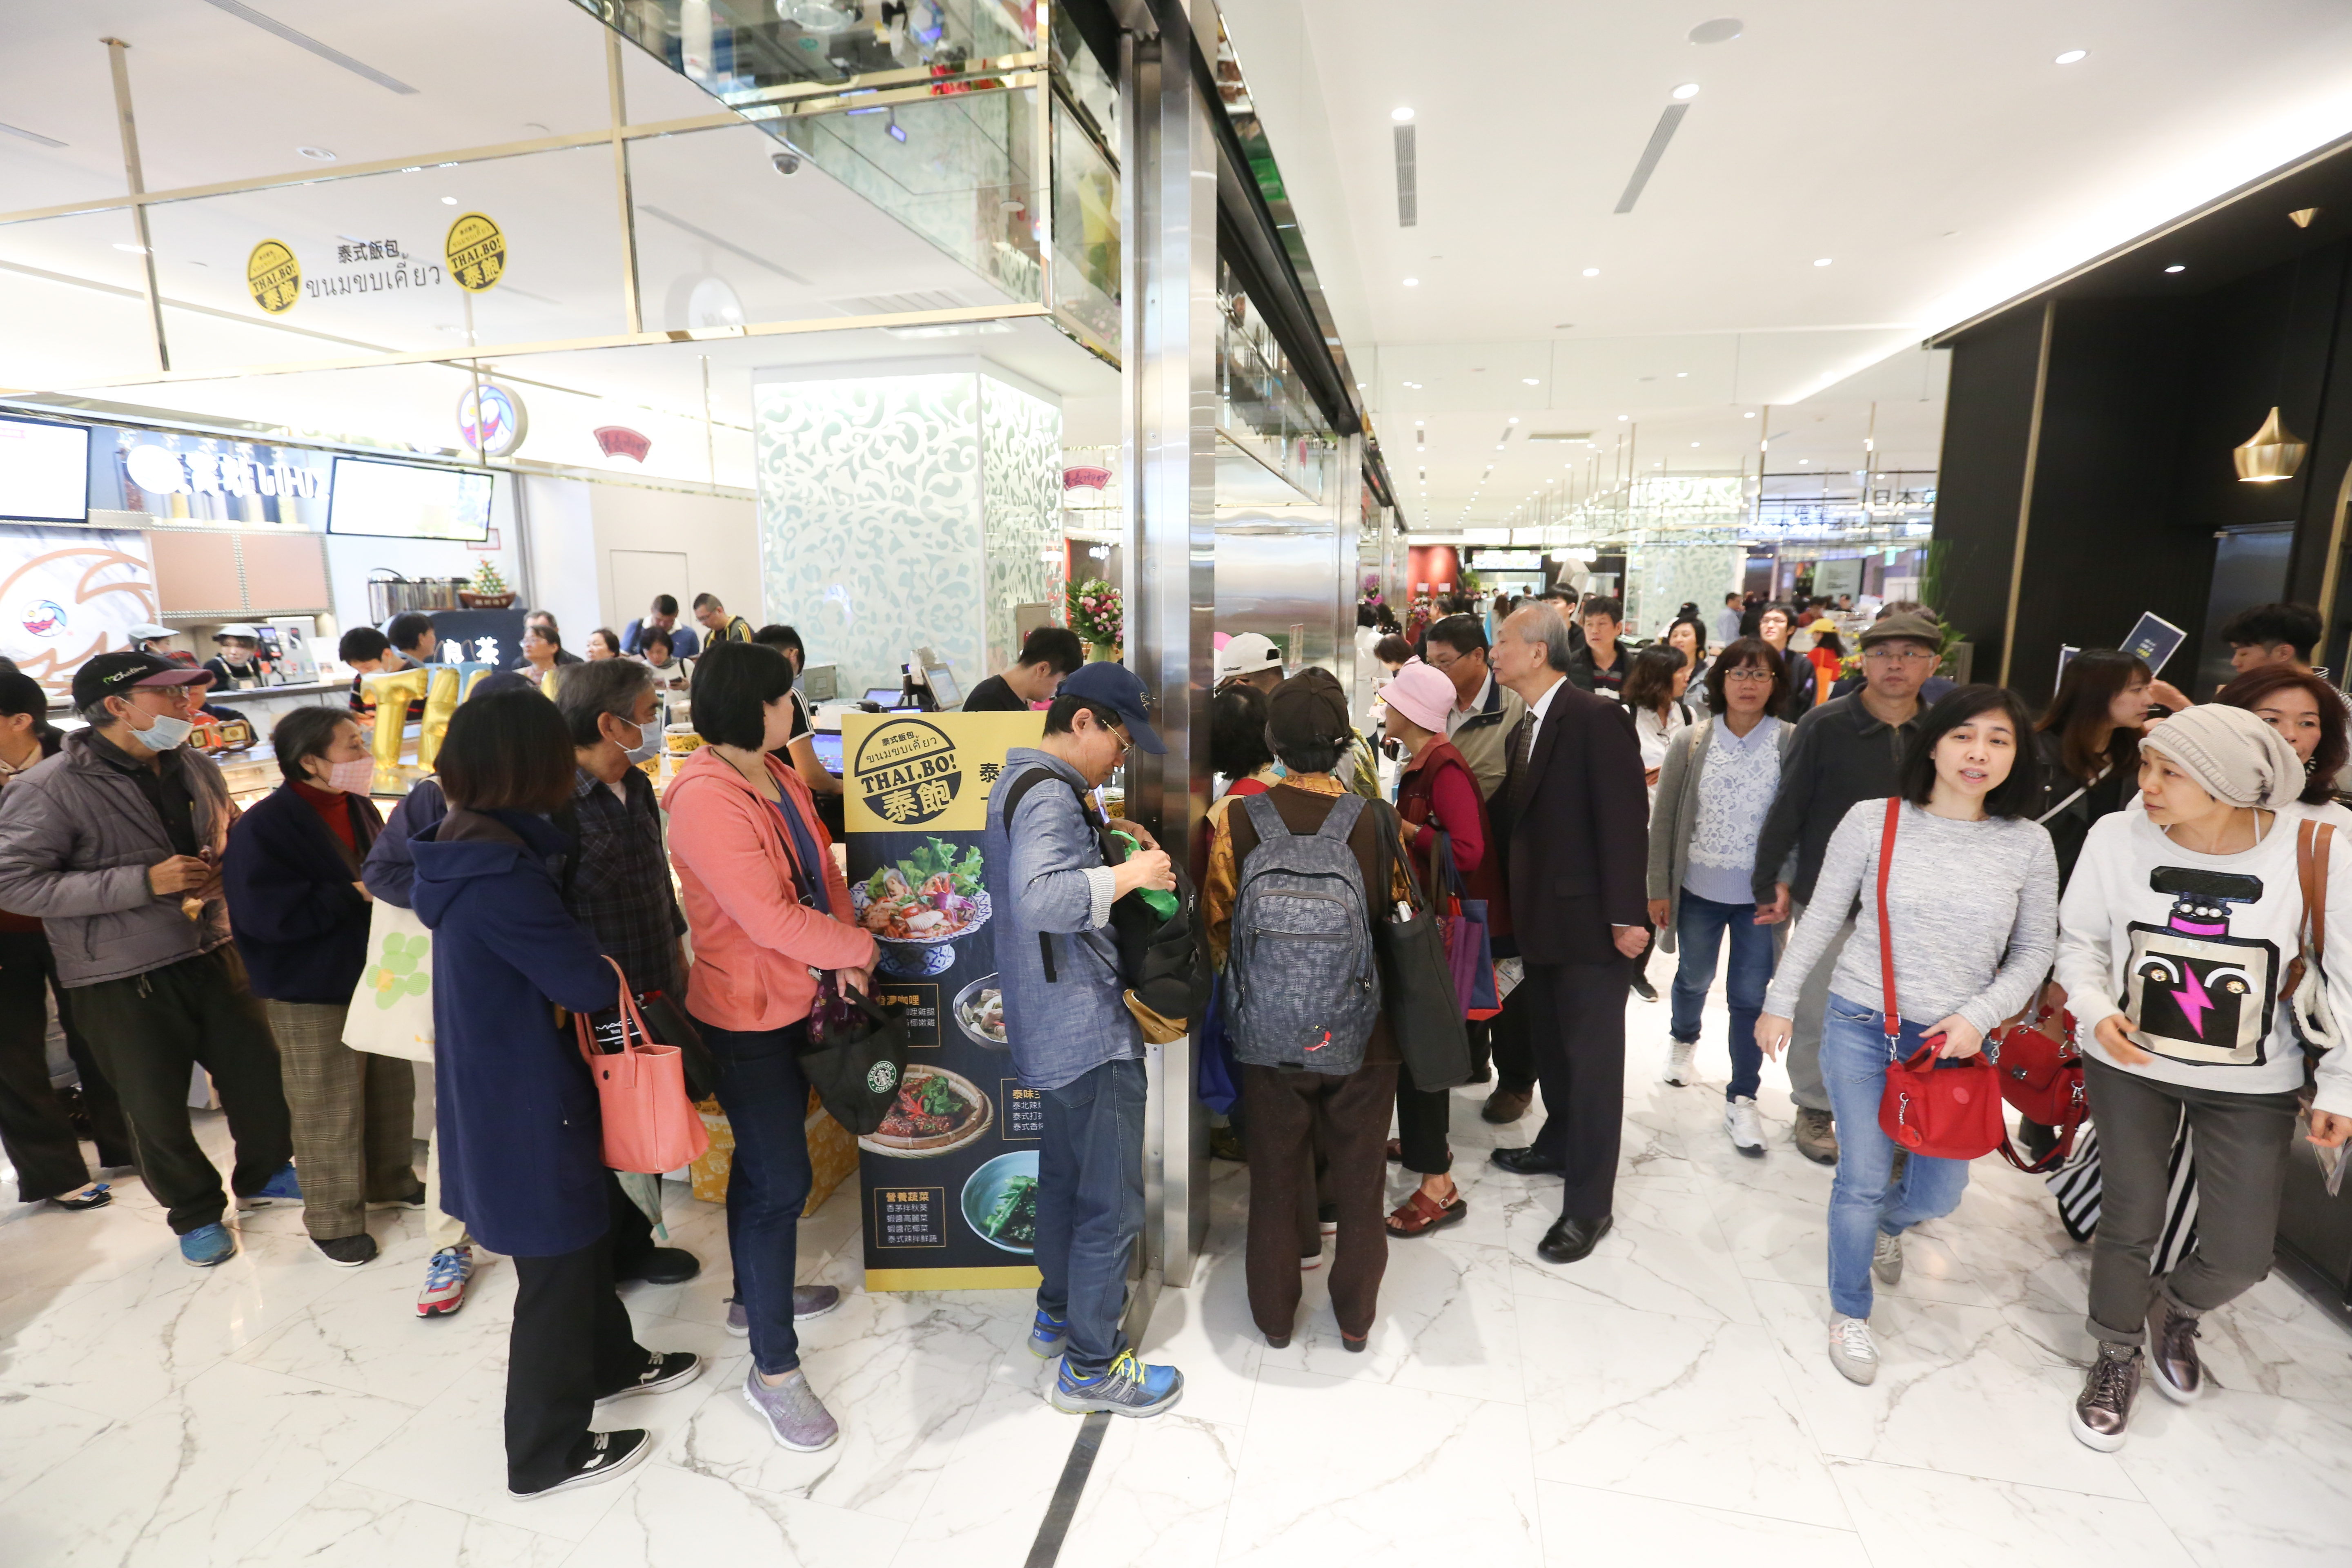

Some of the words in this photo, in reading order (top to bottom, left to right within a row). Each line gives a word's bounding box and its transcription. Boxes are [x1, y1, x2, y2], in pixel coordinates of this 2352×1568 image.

[338, 239, 399, 263] 泰式飯包
[451, 238, 501, 269] THAI.BO!
[881, 731, 914, 746] 泰式飯包
[861, 753, 956, 793] THAI.BO!
[980, 763, 1006, 783] 泰
[881, 780, 954, 822] 泰飽
[869, 1062, 893, 1081] STARBUCKS
[875, 1079, 894, 1091] COFFEE
[886, 1192, 929, 1202] 營養蔬菜
